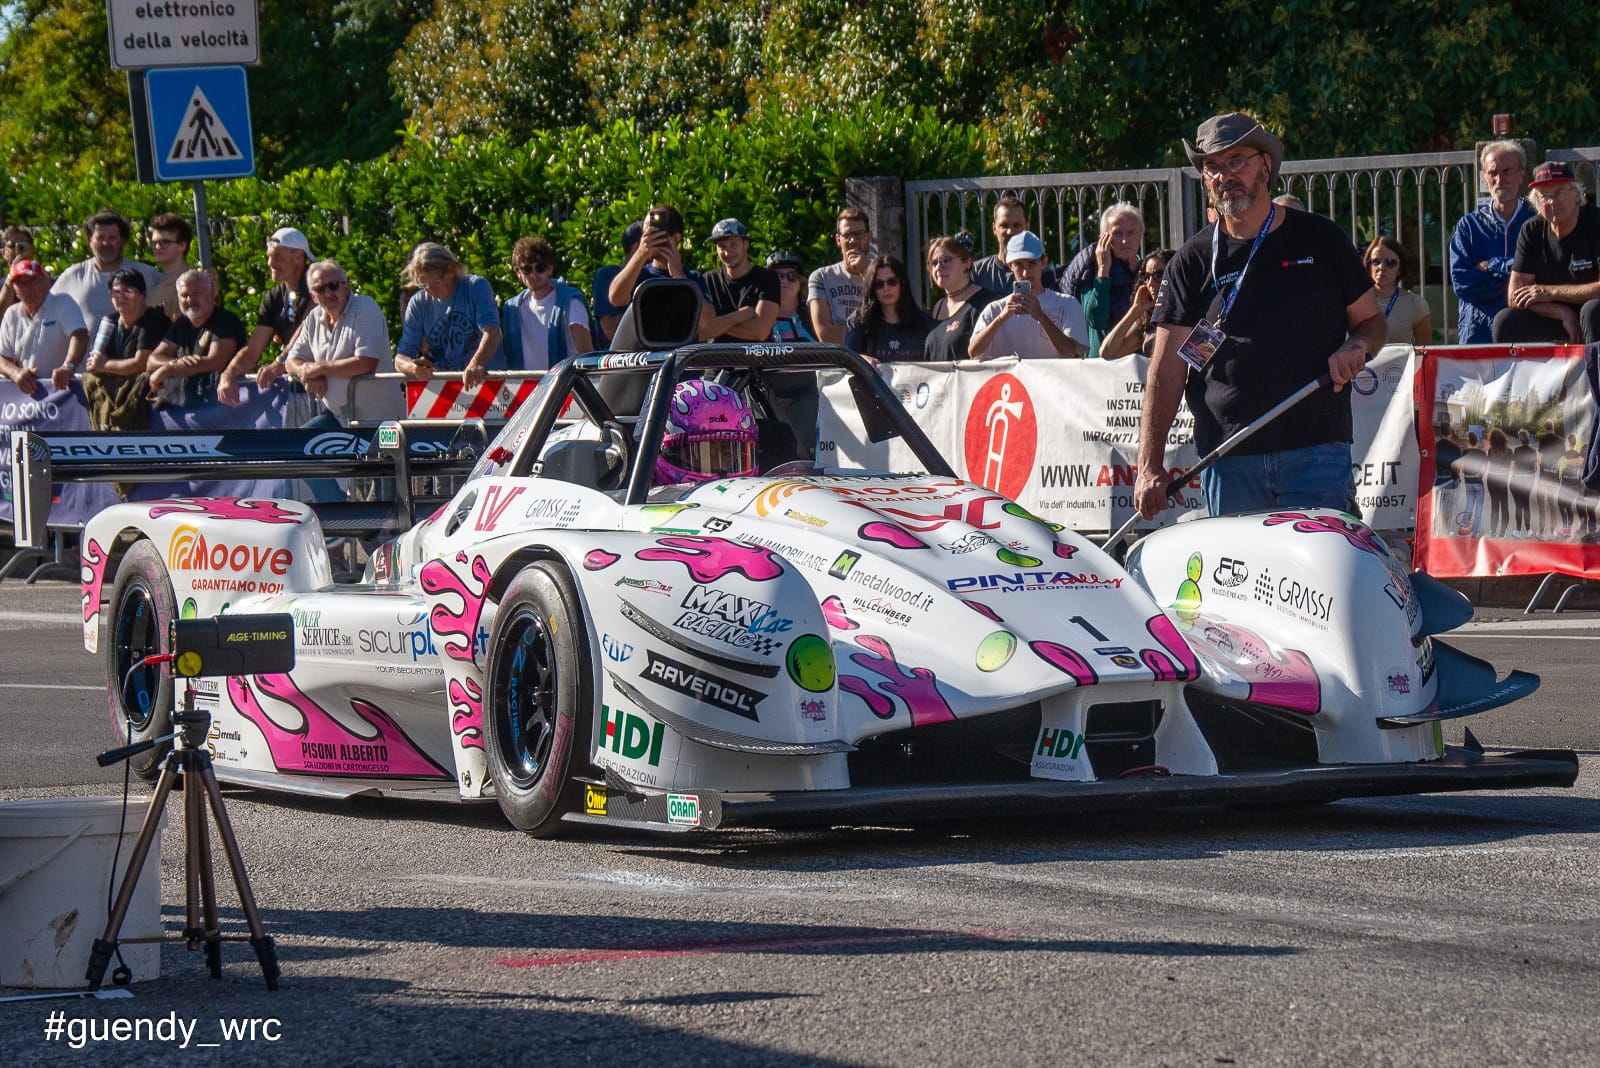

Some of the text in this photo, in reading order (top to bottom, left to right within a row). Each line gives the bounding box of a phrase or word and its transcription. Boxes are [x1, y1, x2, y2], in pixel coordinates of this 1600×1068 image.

[136, 2, 234, 18] elettronico
[124, 30, 248, 49] della velocità
[609, 352, 641, 369] MERLI
[741, 345, 794, 357] TRENTINO
[1, 401, 59, 420] IO SONO
[1083, 431, 1133, 443] IMPIANTI
[49, 443, 209, 457] RAVENOL
[526, 499, 567, 518] GRASSI
[1040, 501, 1050, 509] Via
[1098, 500, 1106, 508] 14
[1361, 494, 1406, 508] 4340957
[191, 578, 256, 593] GARANTIAMO
[850, 569, 934, 612] metalwood.it
[947, 571, 1080, 591] PINTA
[1002, 584, 1113, 593] Motorsport
[680, 584, 771, 628] MAXI
[1279, 577, 1333, 621] GRASSI
[853, 597, 912, 623] HILLCLIMBERS
[226, 631, 287, 643] ALGE-TIMING
[302, 625, 340, 646] SERVICE
[672, 611, 758, 649] RACING
[1068, 615, 1110, 641] 1
[397, 667, 432, 675] SECURITY
[650, 660, 753, 711] RAVENOL
[598, 704, 666, 767] HDI
[1037, 727, 1084, 760] HDI
[301, 742, 389, 762] PISONI ALBERTO
[303, 760, 334, 770] SOLUZIONI
[597, 756, 658, 786] ASSICURAZIONI
[671, 800, 697, 818] ORAM
